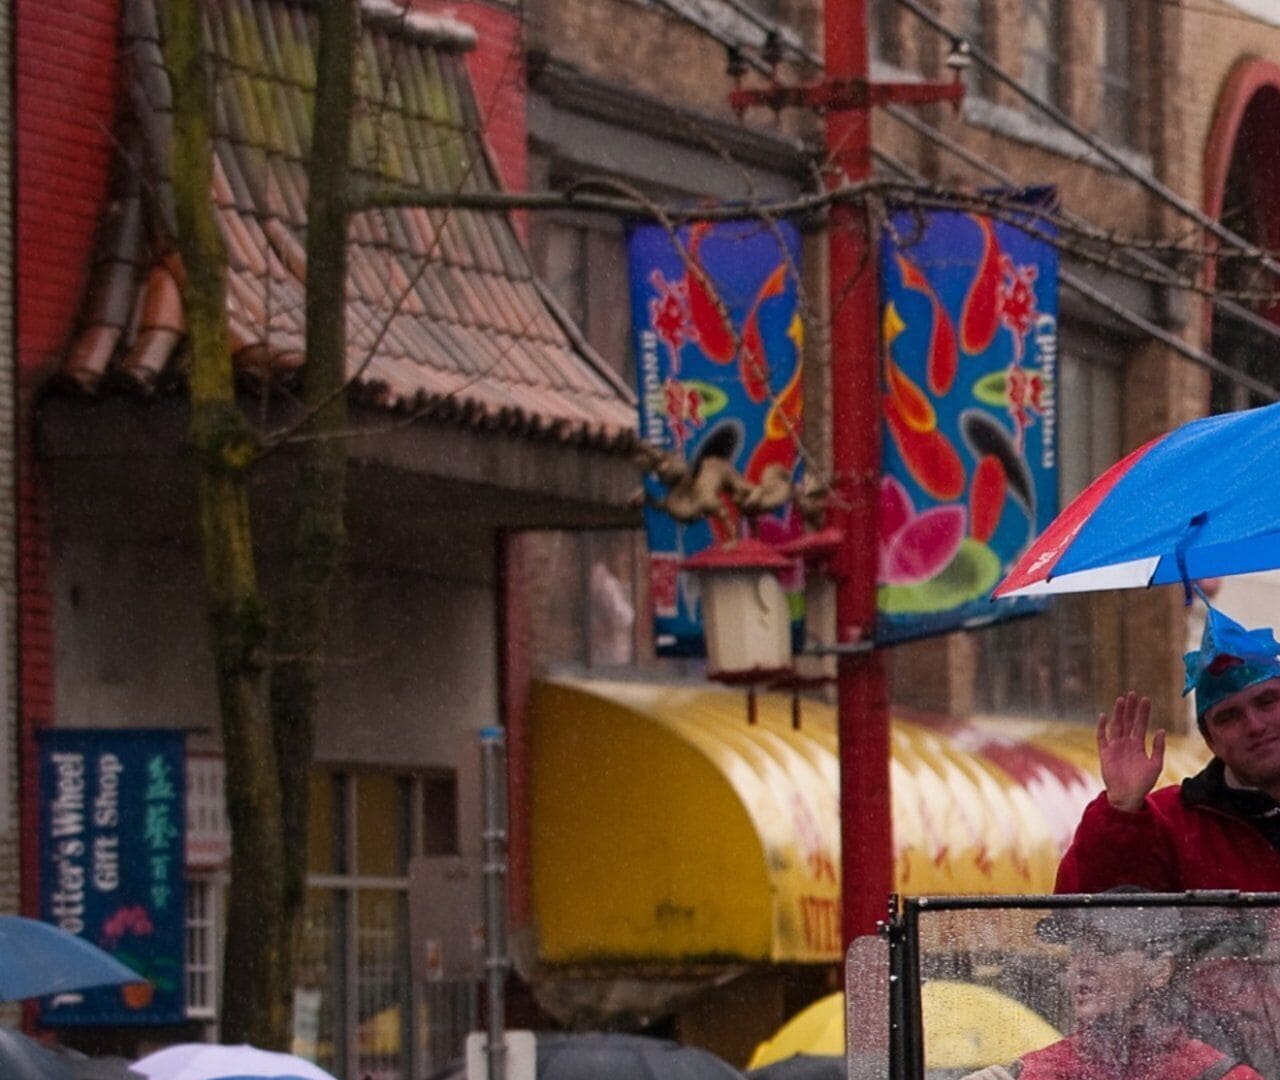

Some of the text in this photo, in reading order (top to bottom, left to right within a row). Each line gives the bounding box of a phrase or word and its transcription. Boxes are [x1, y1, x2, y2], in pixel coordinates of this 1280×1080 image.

[52, 752, 85, 935] otter's Wheel
[94, 753, 124, 892] Gift Shop
